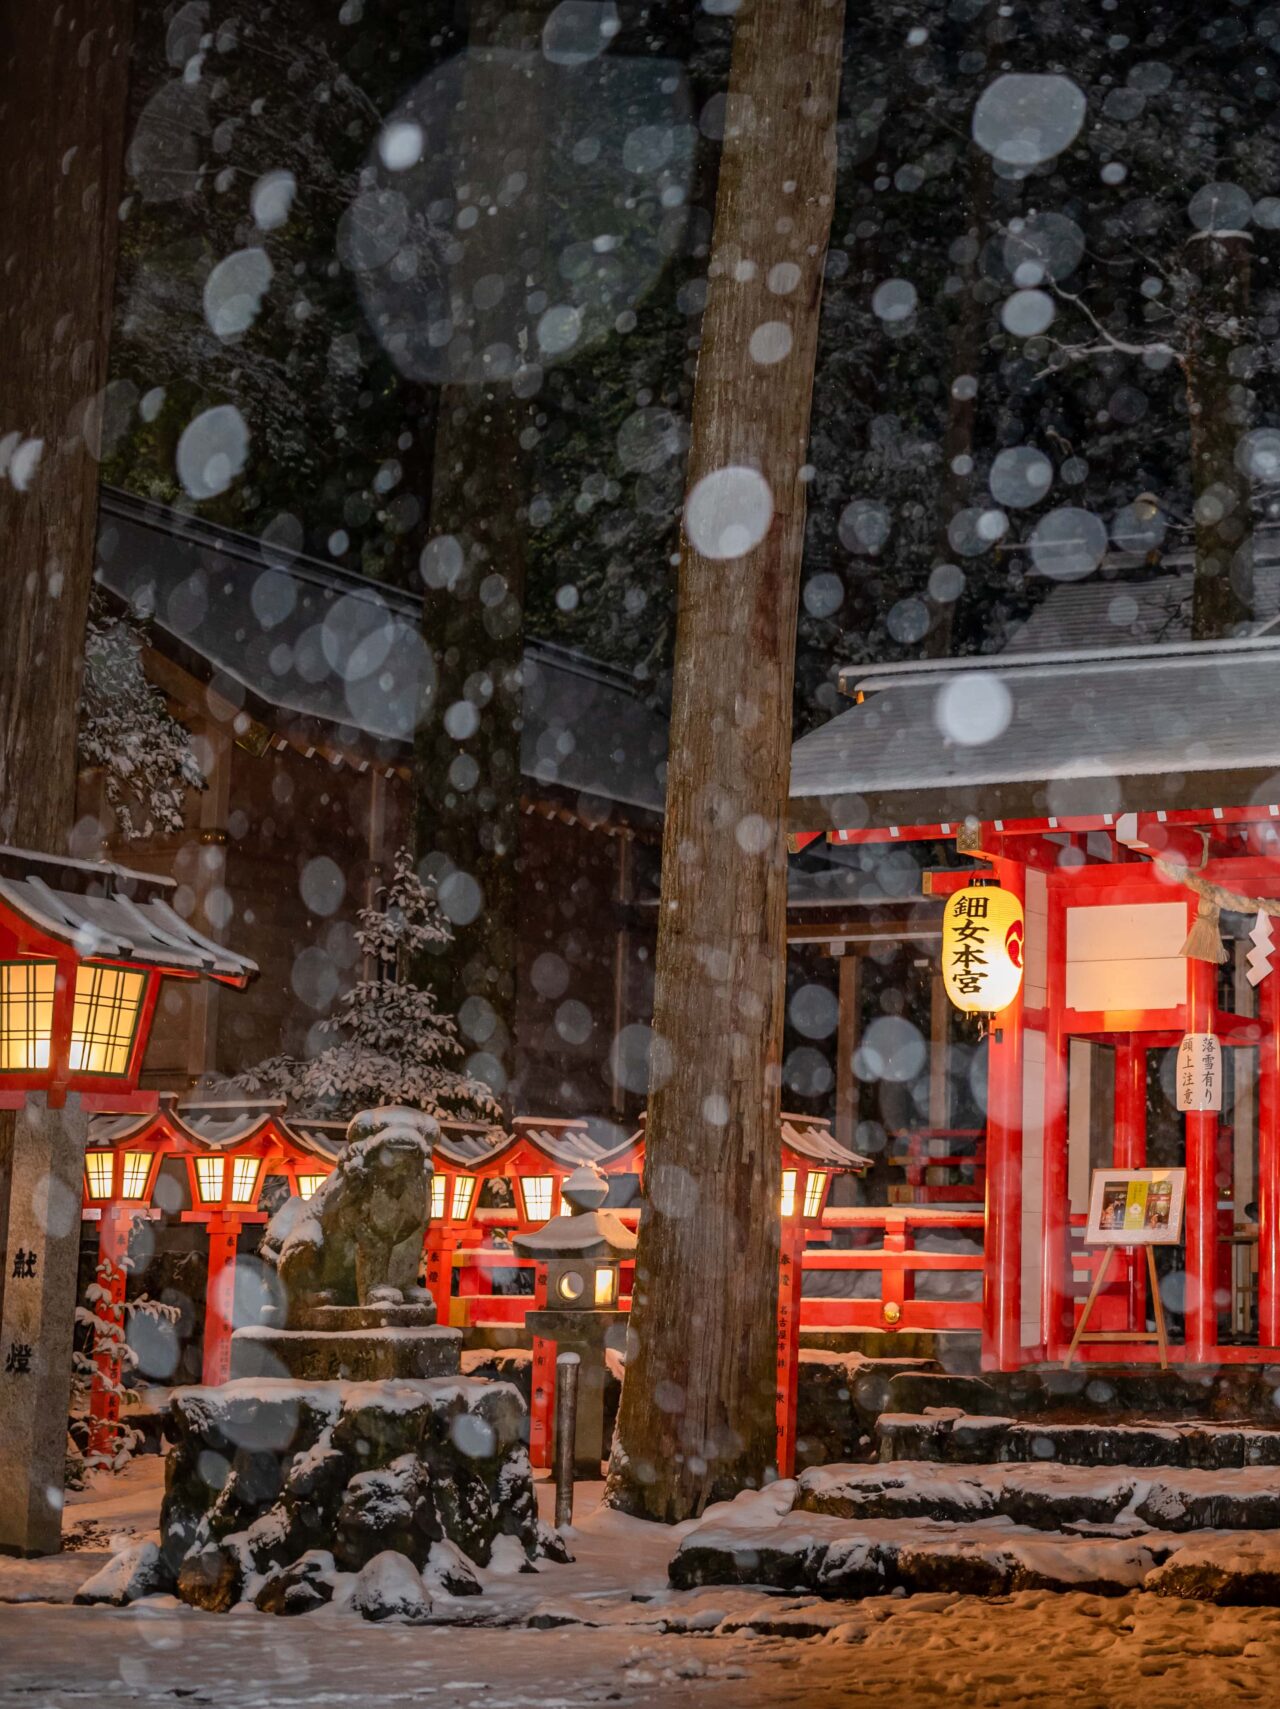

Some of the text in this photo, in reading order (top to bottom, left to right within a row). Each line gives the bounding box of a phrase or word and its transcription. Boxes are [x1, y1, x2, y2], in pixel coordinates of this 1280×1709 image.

[952, 895, 990, 995] 鈿女本宮
[1182, 1037, 1195, 1105] 頭上注意
[1202, 1036, 1216, 1104] 落雪有り
